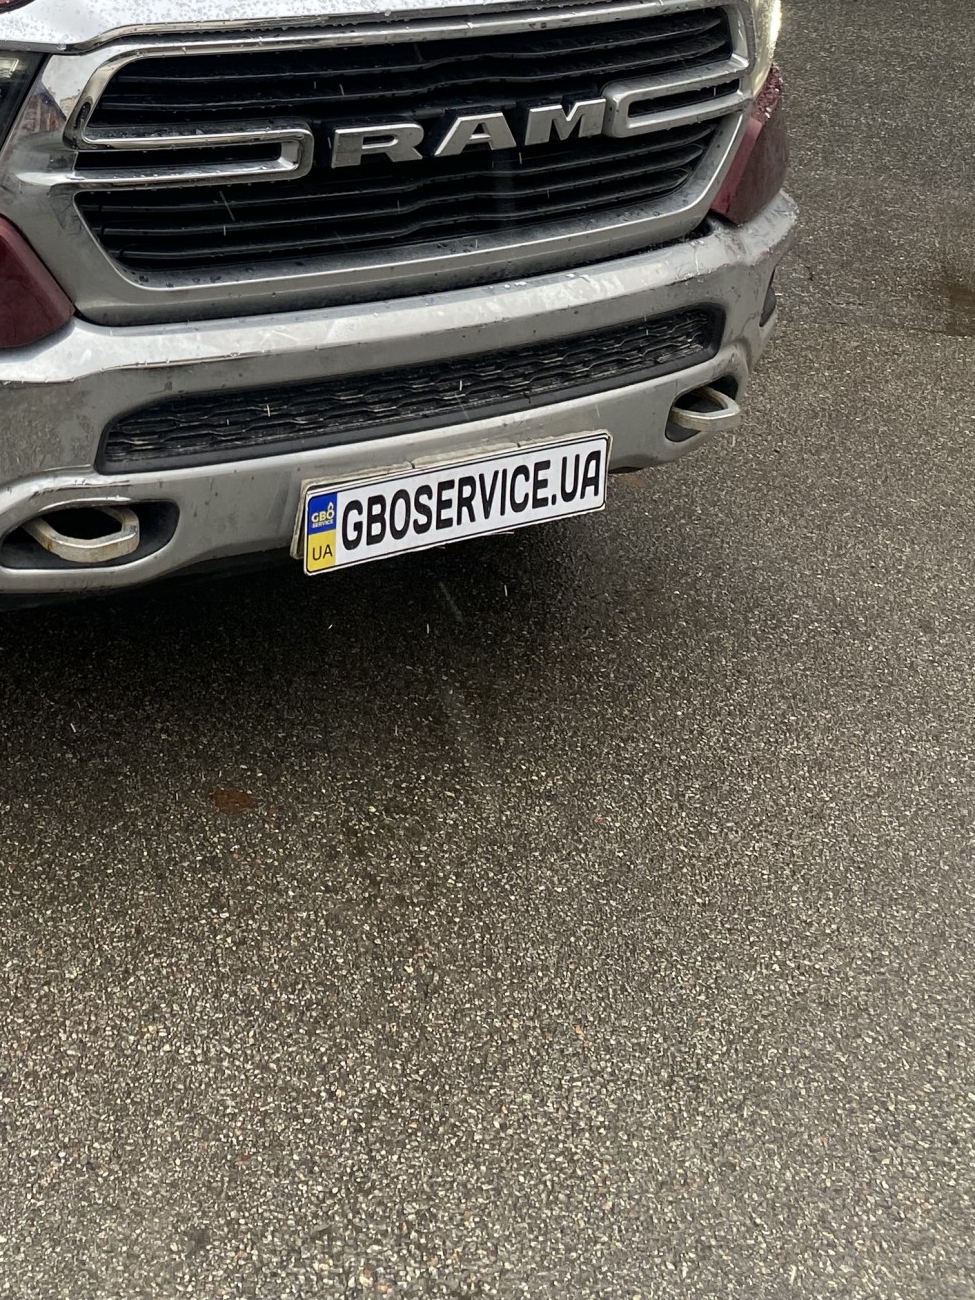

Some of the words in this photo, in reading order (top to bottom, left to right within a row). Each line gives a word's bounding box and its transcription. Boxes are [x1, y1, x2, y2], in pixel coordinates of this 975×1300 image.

[331, 98, 607, 169] RAM
[311, 508, 335, 523] GBO
[341, 449, 602, 551] GBOSERVICE.UA
[312, 544, 333, 561] UA
